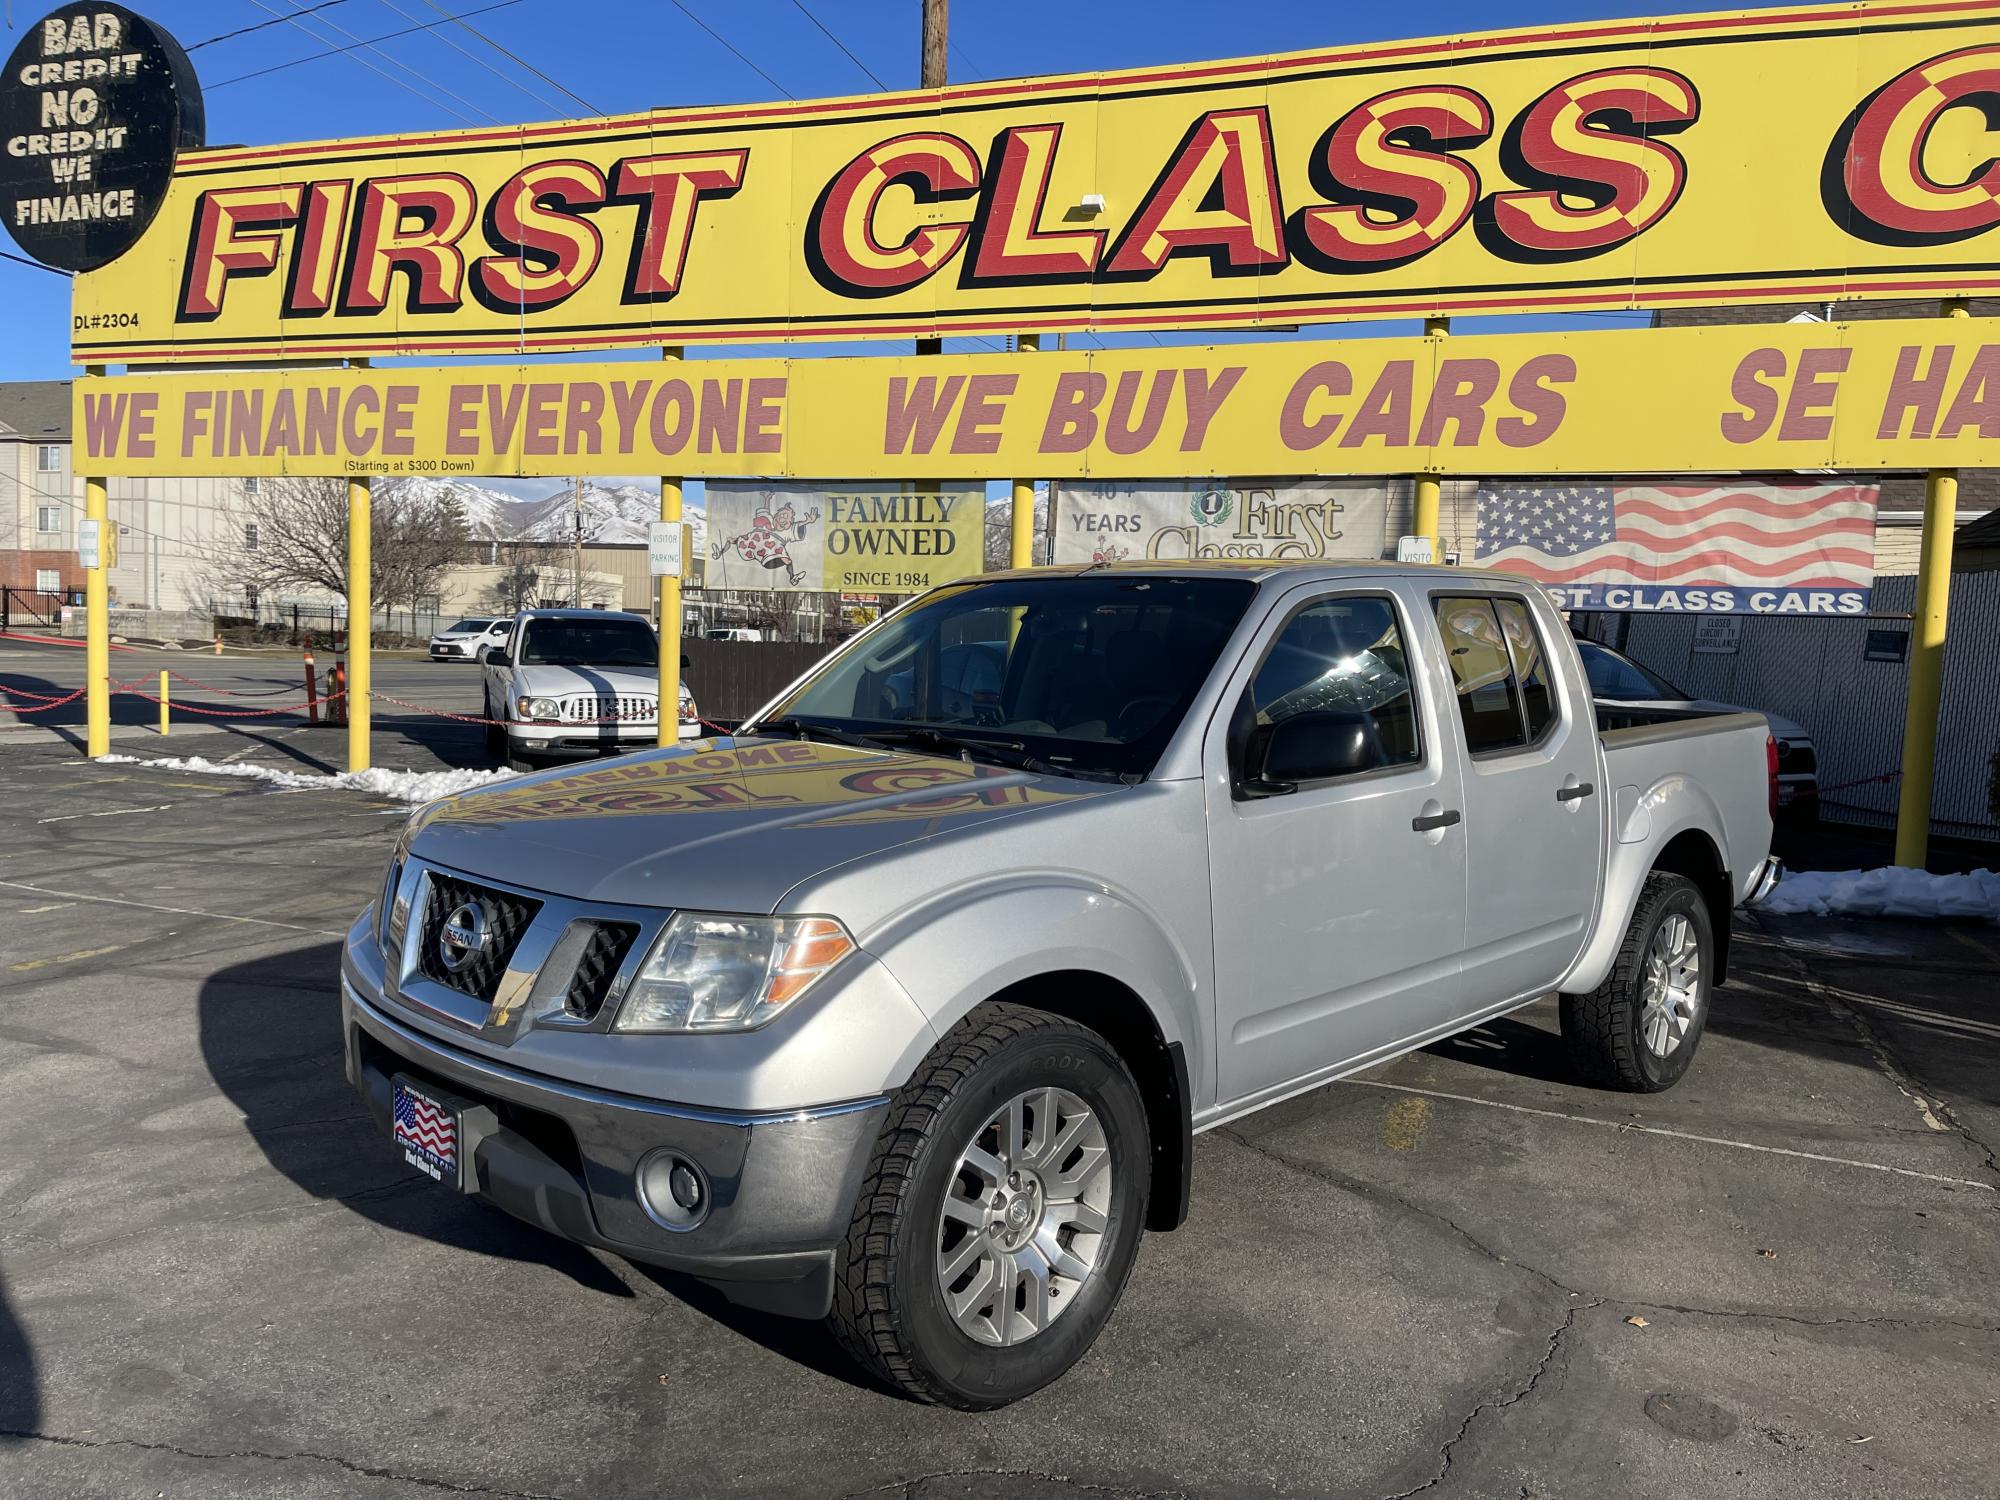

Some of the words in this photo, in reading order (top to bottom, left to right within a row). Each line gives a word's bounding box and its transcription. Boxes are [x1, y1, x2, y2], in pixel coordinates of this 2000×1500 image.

[41, 13, 122, 56] BAD
[20, 53, 142, 87] CREDIT
[41, 87, 99, 128] NO
[7, 126, 128, 157] CREDIT
[51, 155, 92, 183] WE
[16, 189, 135, 226] FINANCE
[174, 148, 750, 323] FIRST
[804, 66, 1701, 299] CLASS
[74, 313, 139, 329] DL#2304
[83, 392, 160, 458] WE
[181, 384, 420, 457] FINANCE
[446, 377, 788, 455] EVERYONE
[883, 374, 1020, 455] WE
[1038, 366, 1247, 454] BUY
[1279, 353, 1577, 452] CARS
[1720, 346, 1853, 444] SE
[344, 460, 389, 472] (Starting
[393, 461, 403, 471] at
[408, 460, 437, 471] $300
[441, 459, 475, 472] Down)
[827, 496, 957, 523] FAMILY
[1072, 513, 1142, 533] YEARS
[1232, 487, 1344, 559] First
[653, 534, 678, 544] VISITOR
[827, 528, 956, 556] OWNED
[651, 553, 679, 563] PARKING
[843, 572, 891, 587] SINCE
[895, 572, 930, 587] 1984
[1605, 589, 1735, 612] CLASS
[1750, 592, 1863, 613] CARS
